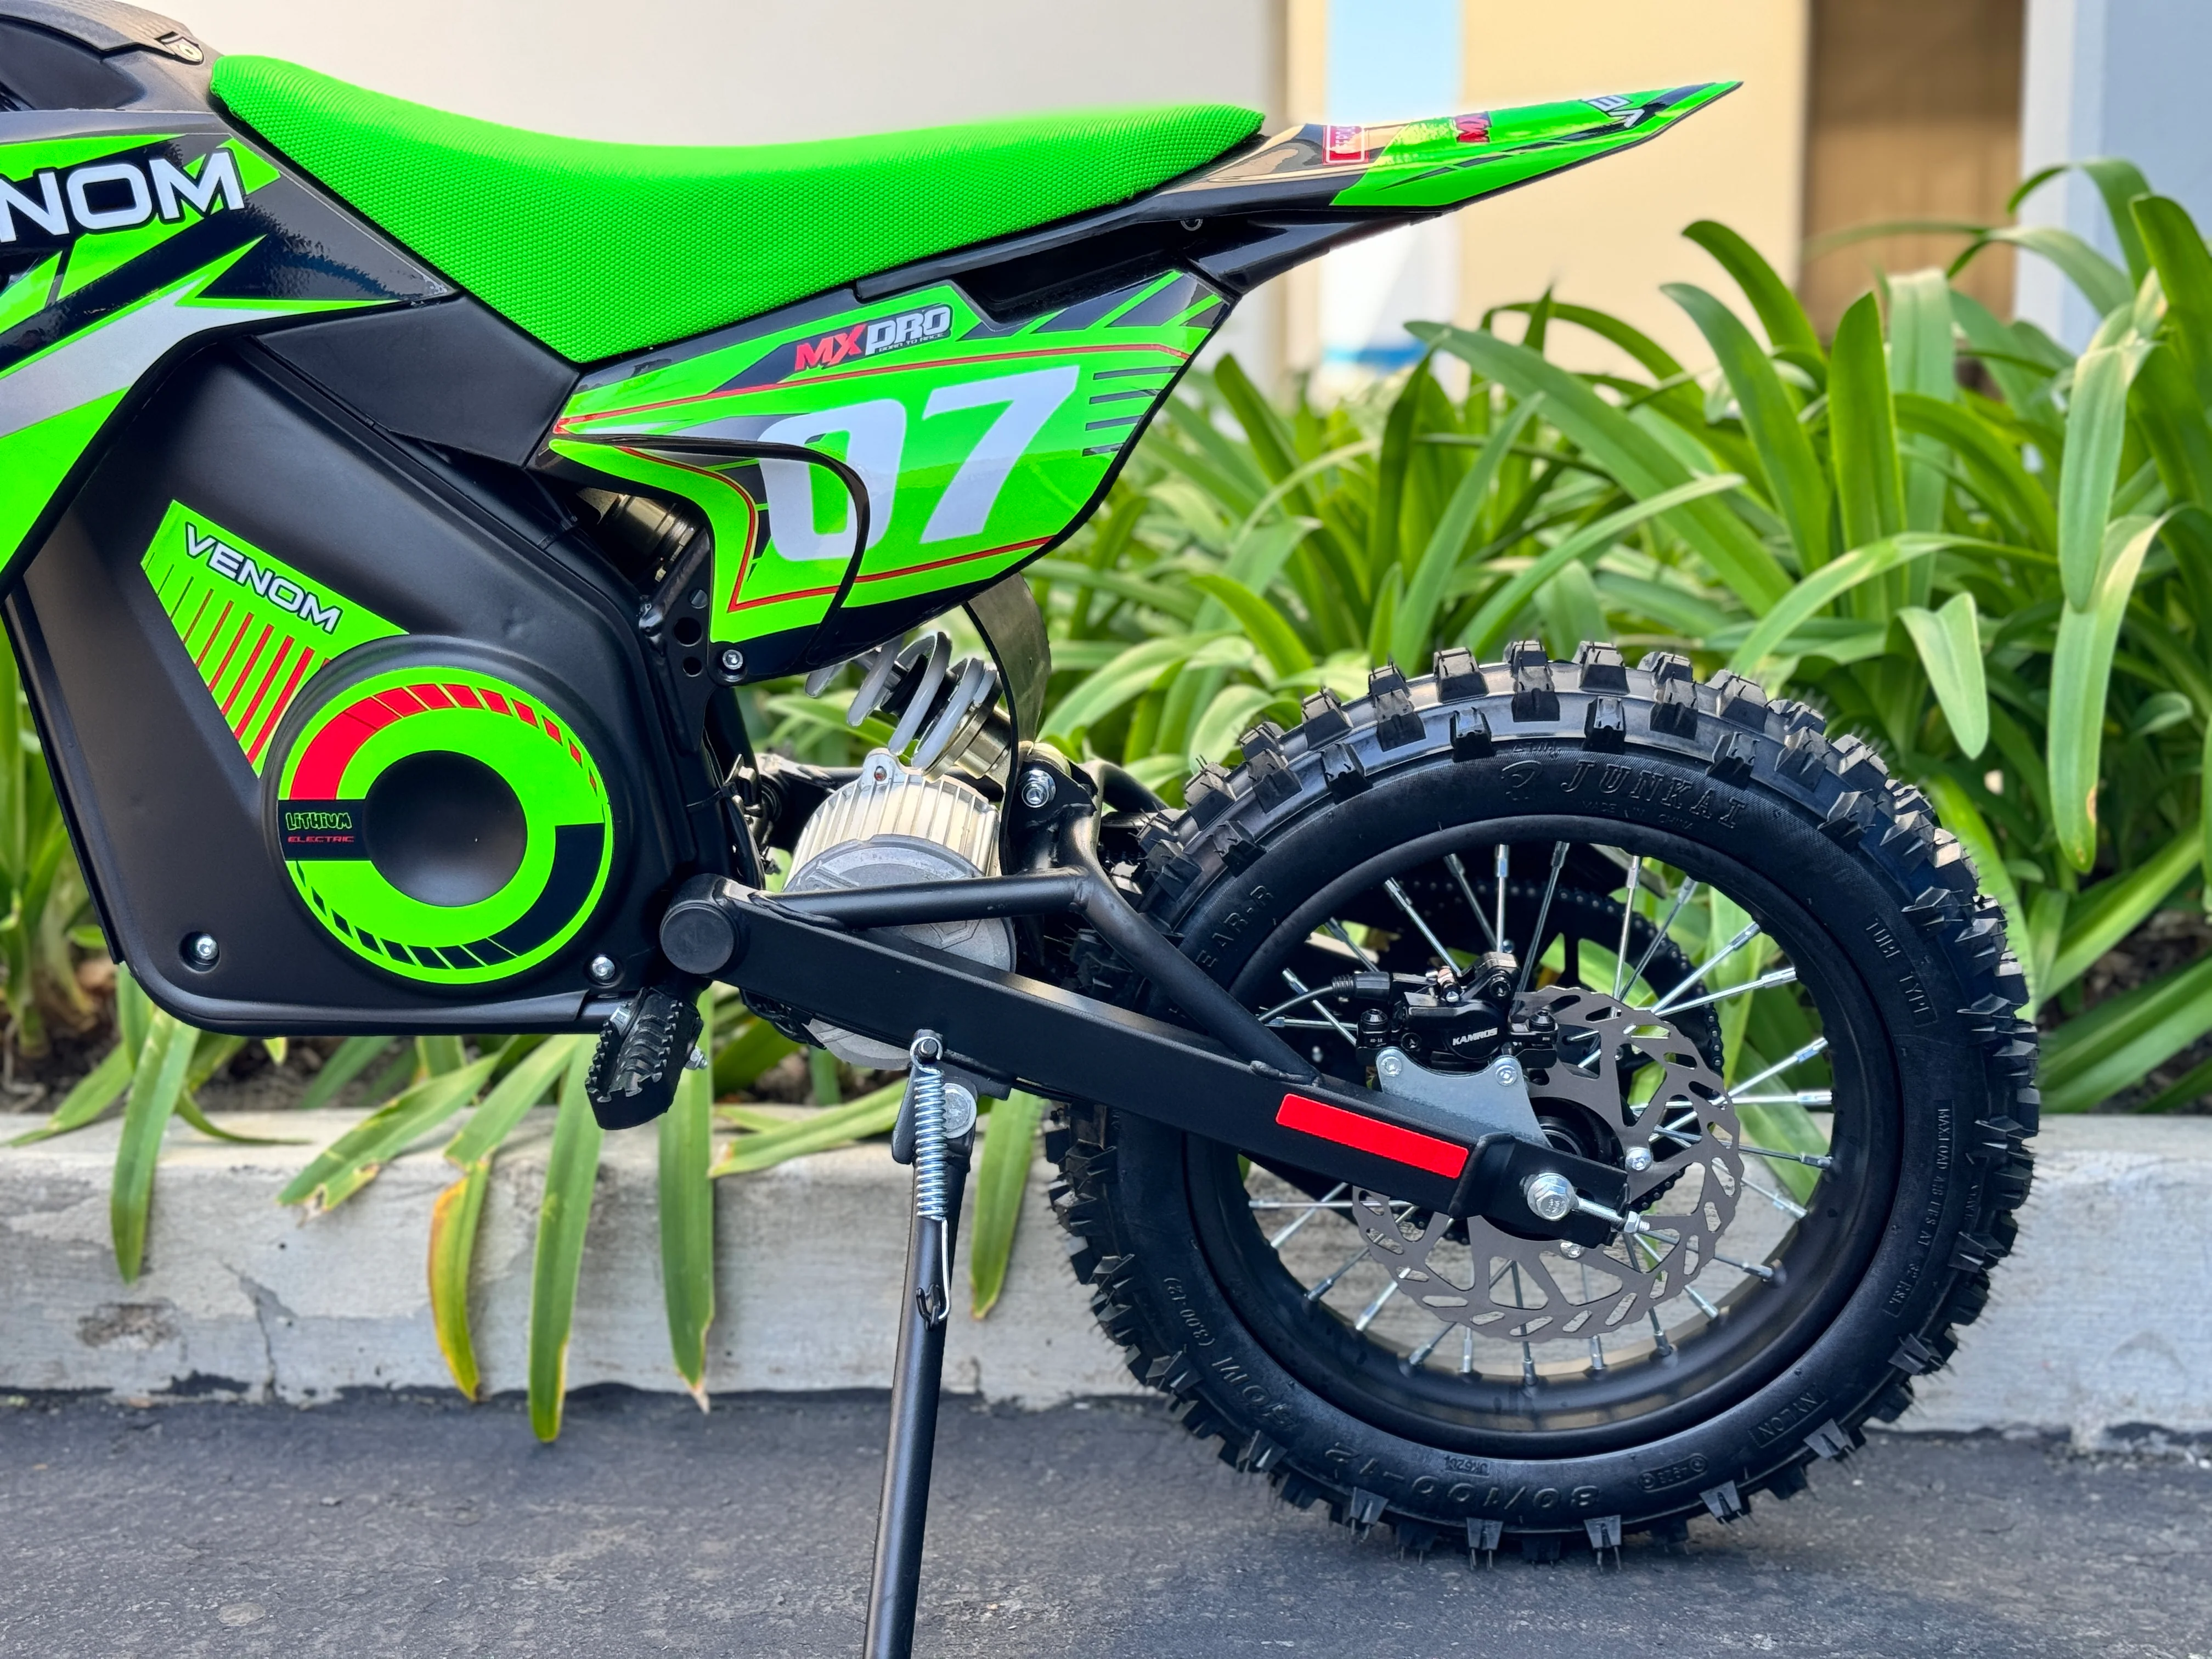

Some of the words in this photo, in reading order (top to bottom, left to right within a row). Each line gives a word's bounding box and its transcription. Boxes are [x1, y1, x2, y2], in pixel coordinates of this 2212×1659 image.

[758, 365, 1080, 562] 07
[184, 523, 343, 634] VENOM
[1560, 759, 1746, 829] JUNKAI
[1582, 800, 1617, 814] MADE
[1865, 917, 1901, 966] TUBE
[1899, 970, 1933, 1017] TYPE
[1917, 1230, 1932, 1246] AT
[1757, 1391, 1820, 1440] NYLON
[1325, 1441, 1600, 1510] 80/100-12
